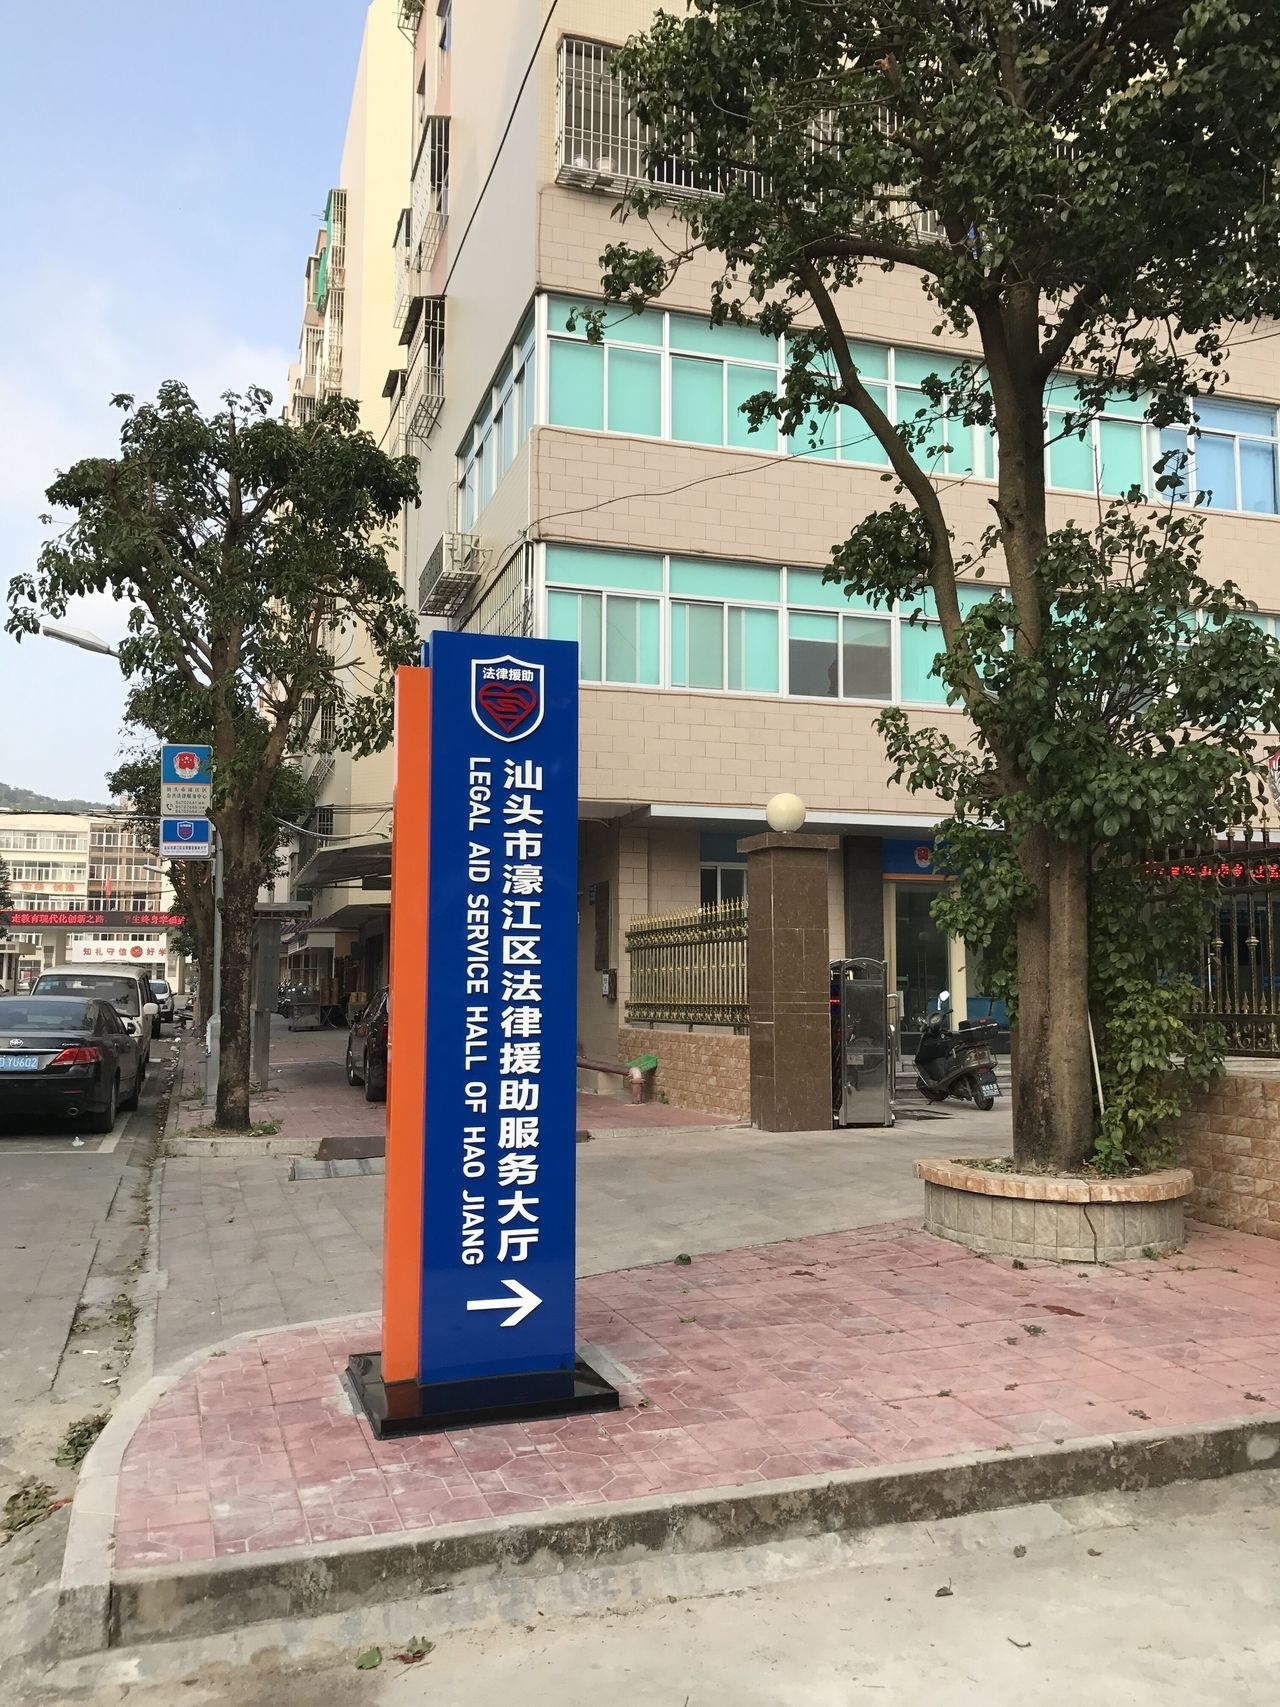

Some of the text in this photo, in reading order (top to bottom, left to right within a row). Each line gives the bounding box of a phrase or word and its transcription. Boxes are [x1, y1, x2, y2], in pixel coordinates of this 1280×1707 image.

[482, 666, 535, 682] 法律援助
[461, 757, 491, 1265] LEGAL AID SERVICE HALL OF HAO JIANG
[496, 758, 544, 1263] 汕头市濠江区法律援助服务大厅
